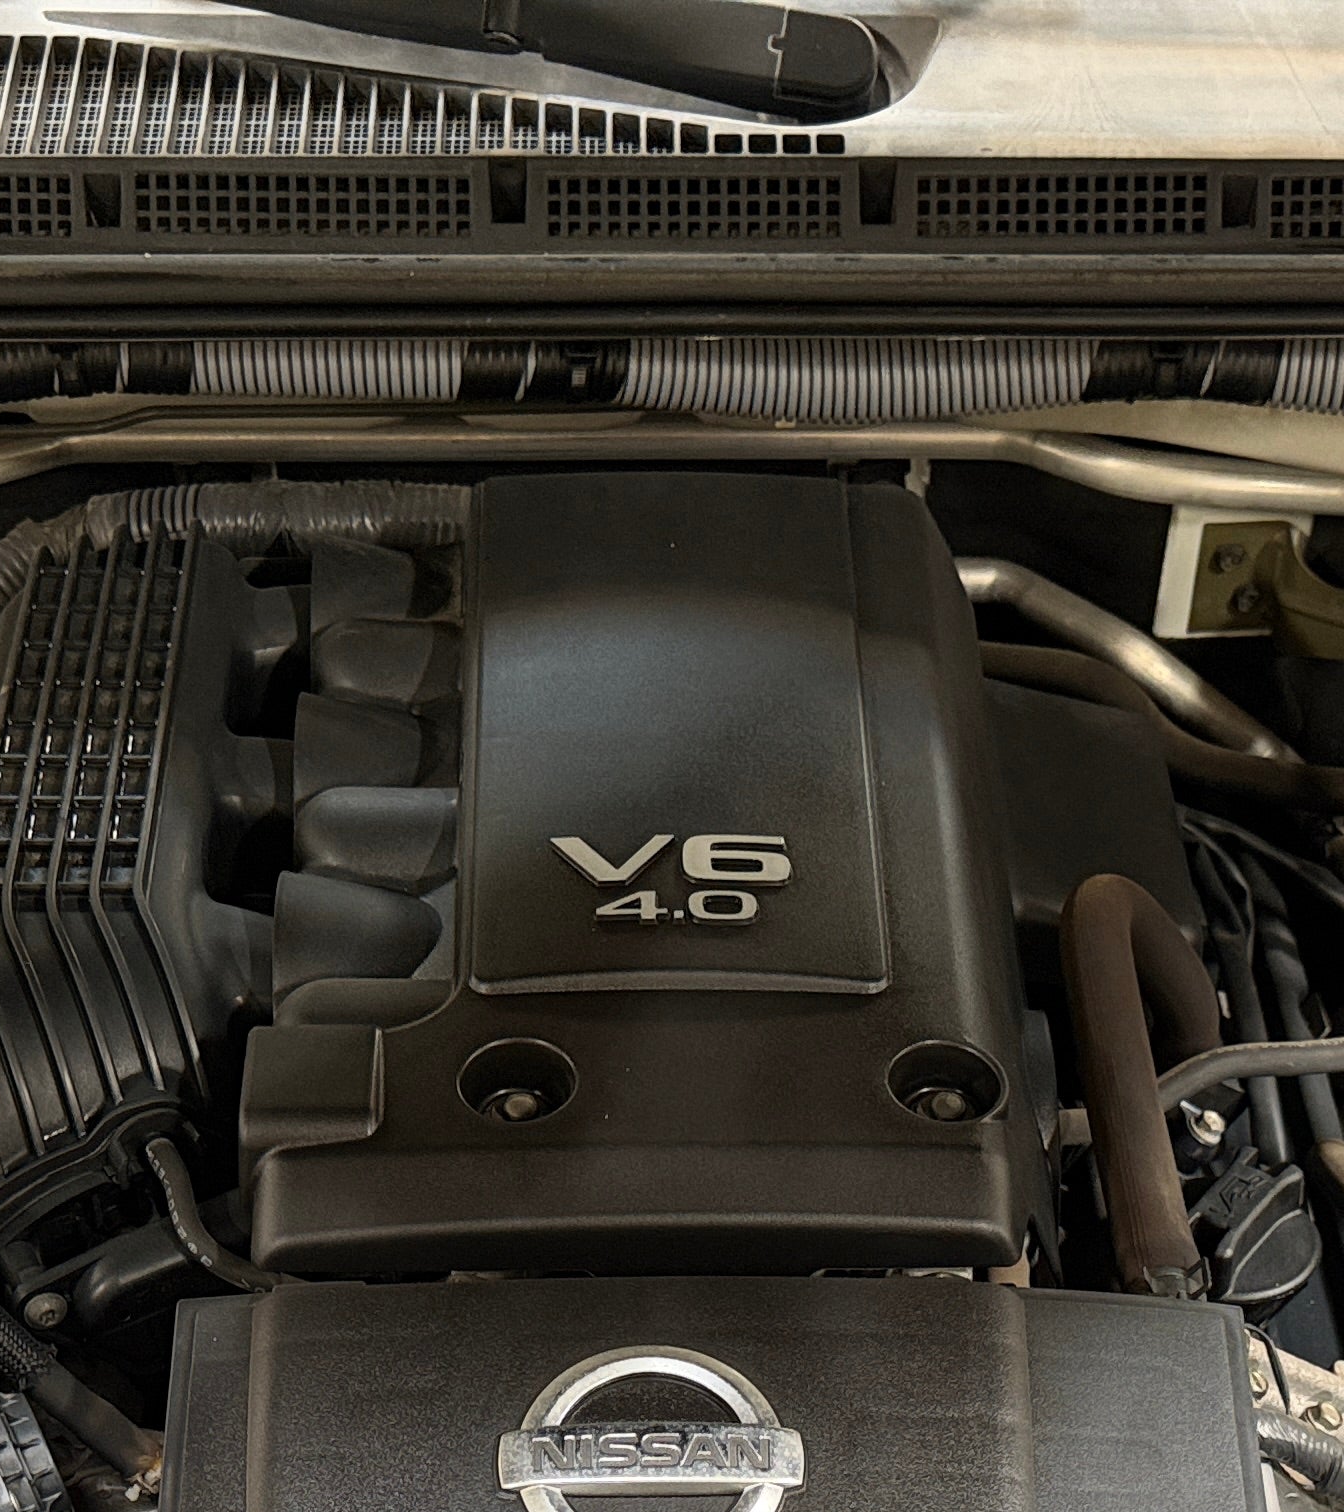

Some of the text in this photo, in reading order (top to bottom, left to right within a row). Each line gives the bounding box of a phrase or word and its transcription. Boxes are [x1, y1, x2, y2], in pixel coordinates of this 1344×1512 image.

[549, 834, 793, 886] V6
[594, 889, 760, 924] 4.0
[528, 1430, 773, 1473] NISSAN
